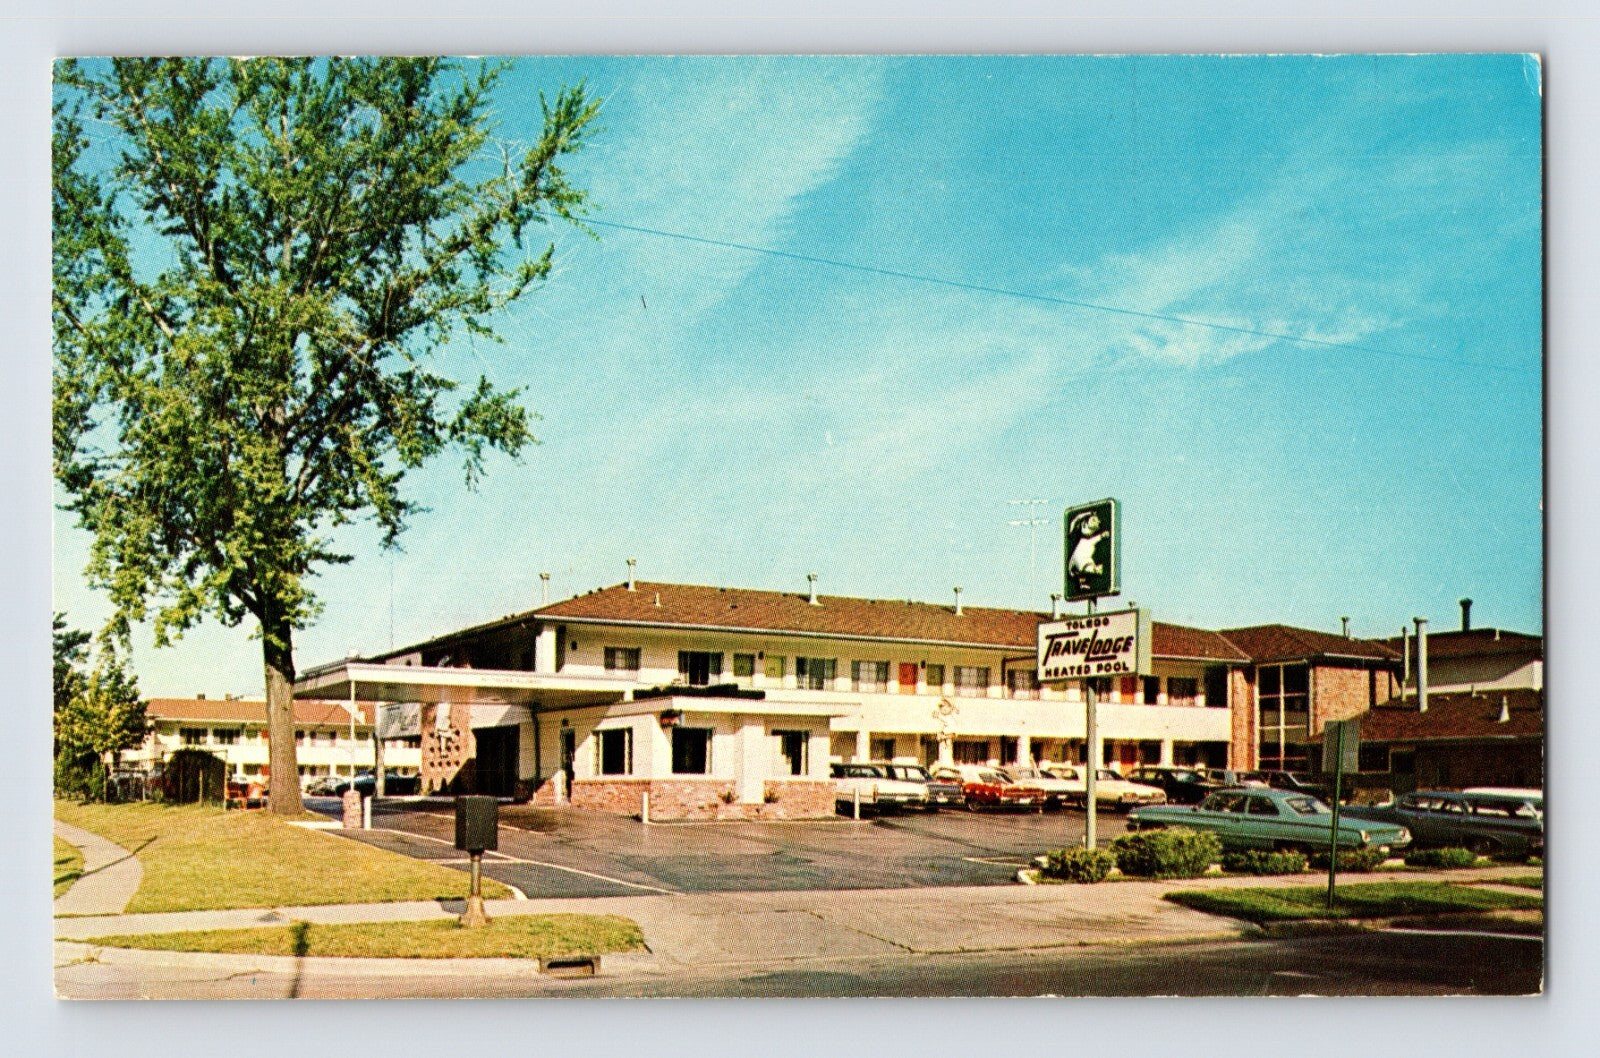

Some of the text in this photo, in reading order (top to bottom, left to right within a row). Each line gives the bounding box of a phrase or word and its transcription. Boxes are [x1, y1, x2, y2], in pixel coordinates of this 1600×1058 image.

[1066, 617, 1110, 630] TOLEDO
[1045, 662, 1129, 677] HEATED POOL
